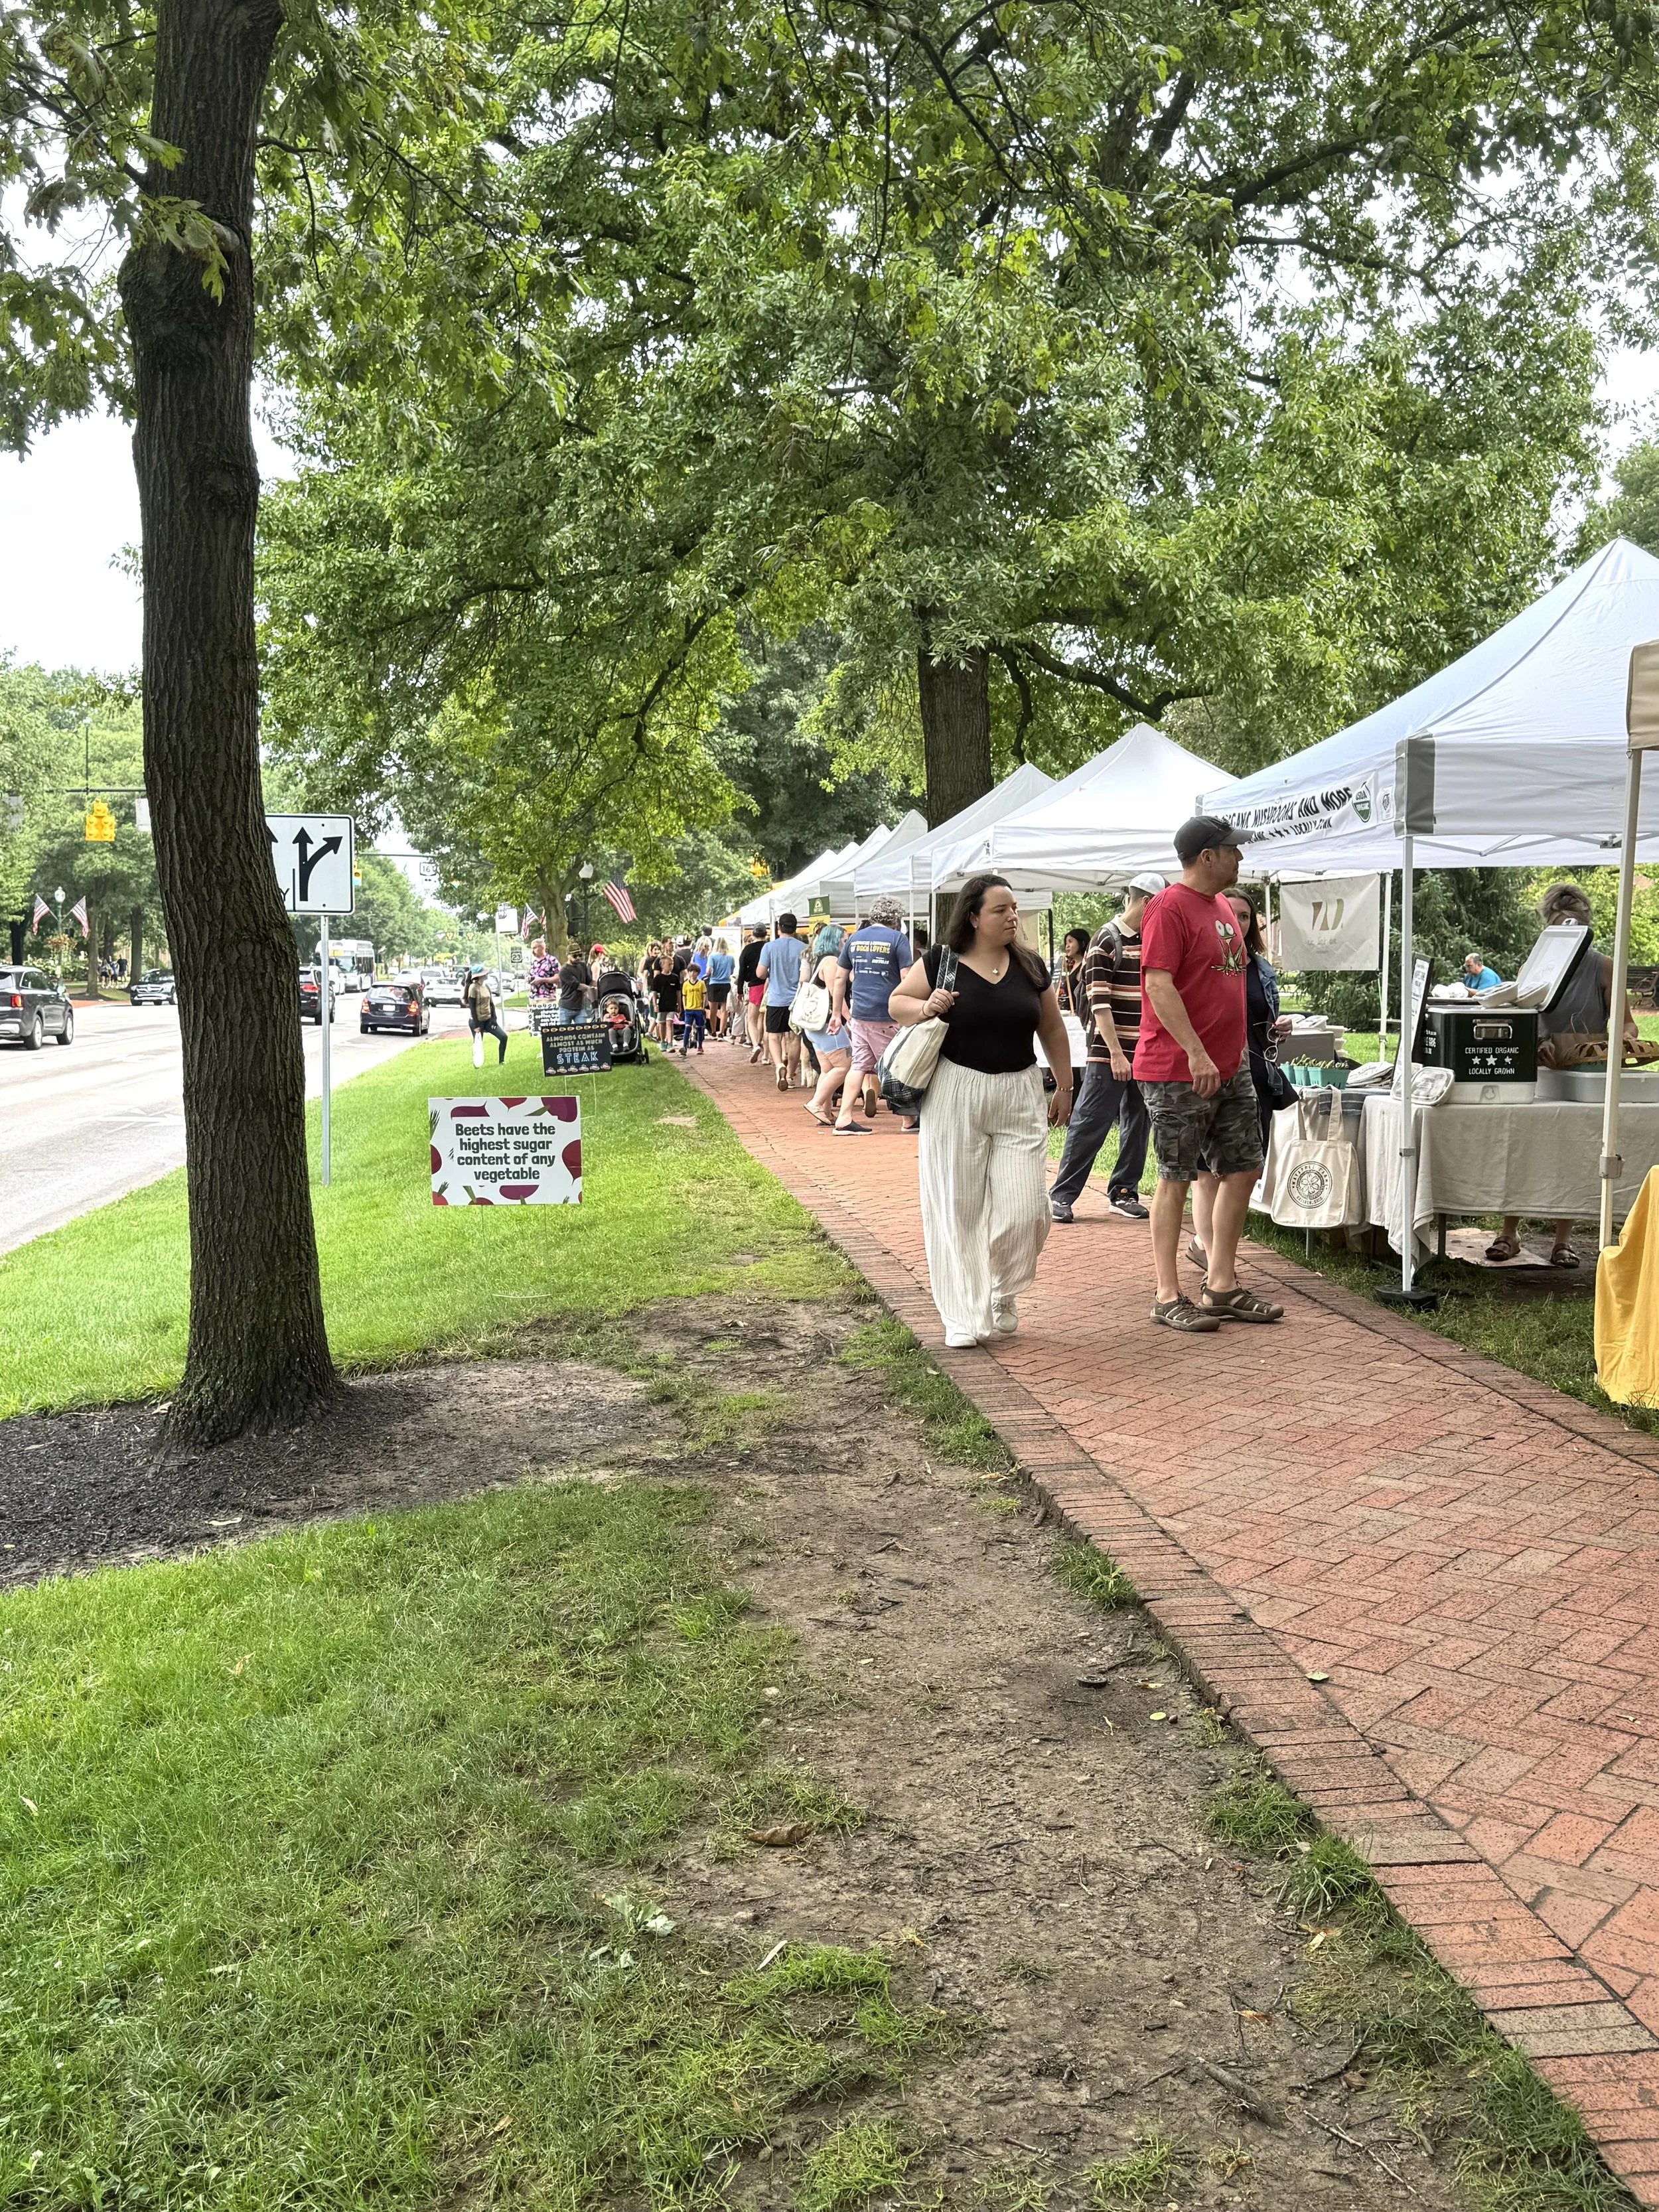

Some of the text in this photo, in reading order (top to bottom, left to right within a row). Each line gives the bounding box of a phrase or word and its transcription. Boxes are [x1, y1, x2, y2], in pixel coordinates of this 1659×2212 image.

[1298, 795, 1320, 818] AND
[557, 1051, 599, 1065] STEAK
[455, 1122, 555, 1136] Beets have the
[459, 1138, 552, 1153] highest sugar
[457, 1153, 555, 1167] content of any
[474, 1167, 540, 1183] vegetable
